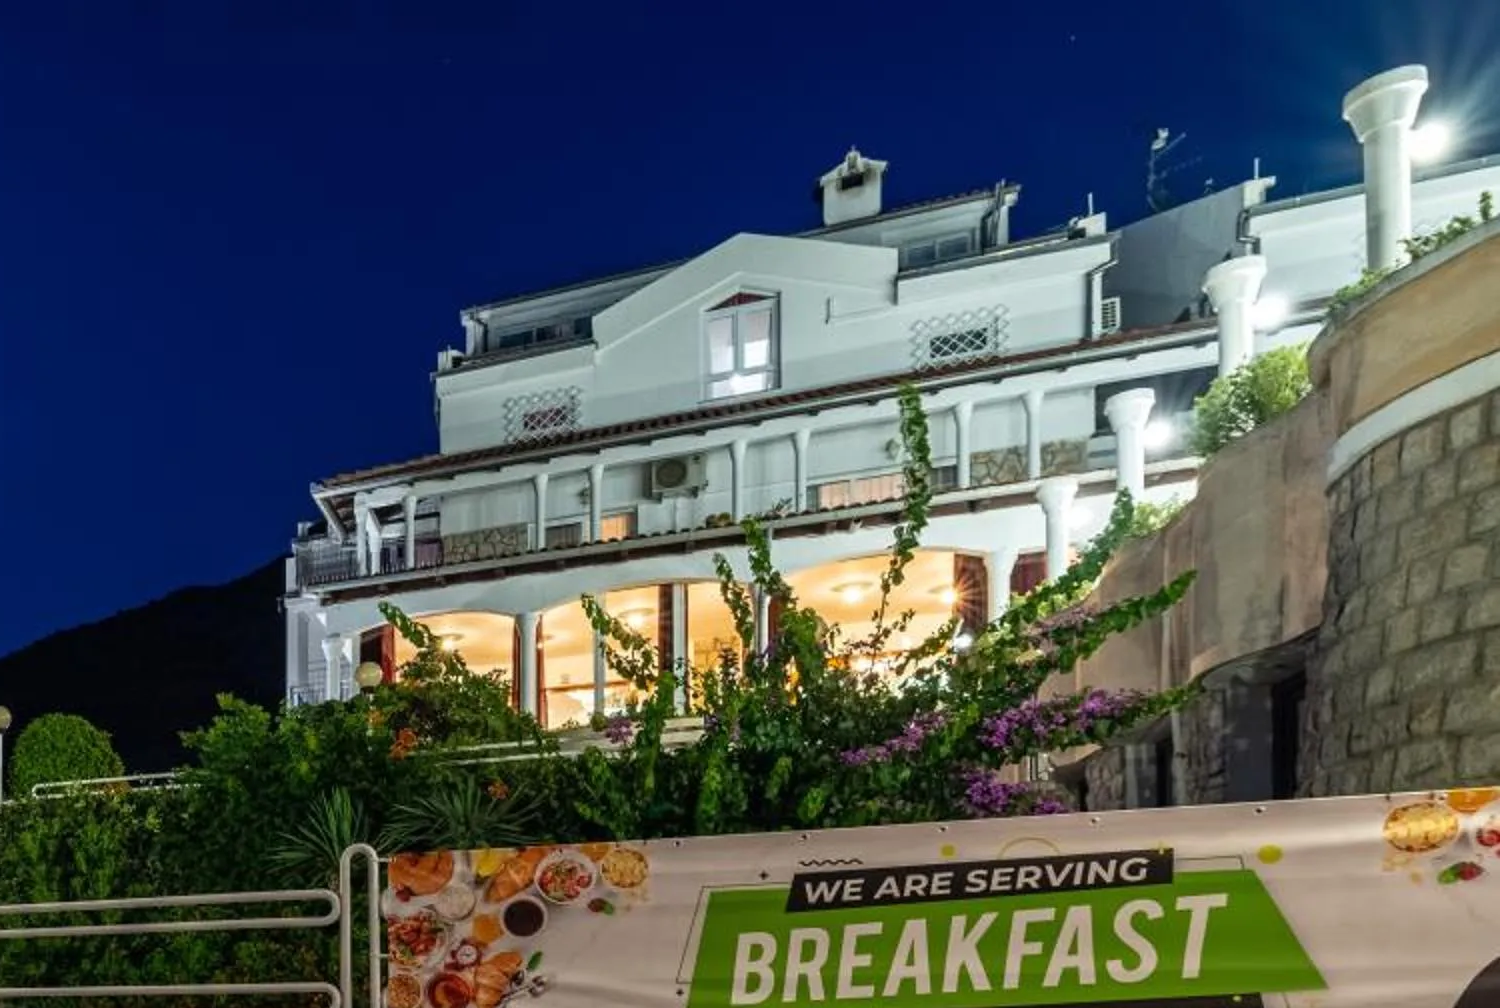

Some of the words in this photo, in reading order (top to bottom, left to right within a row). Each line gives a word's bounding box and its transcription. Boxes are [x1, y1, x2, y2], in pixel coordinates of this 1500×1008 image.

[804, 878, 865, 904] WE
[874, 872, 954, 899] ARE
[964, 857, 1150, 894] SERVING
[730, 893, 1228, 1006] BREAKFAST
